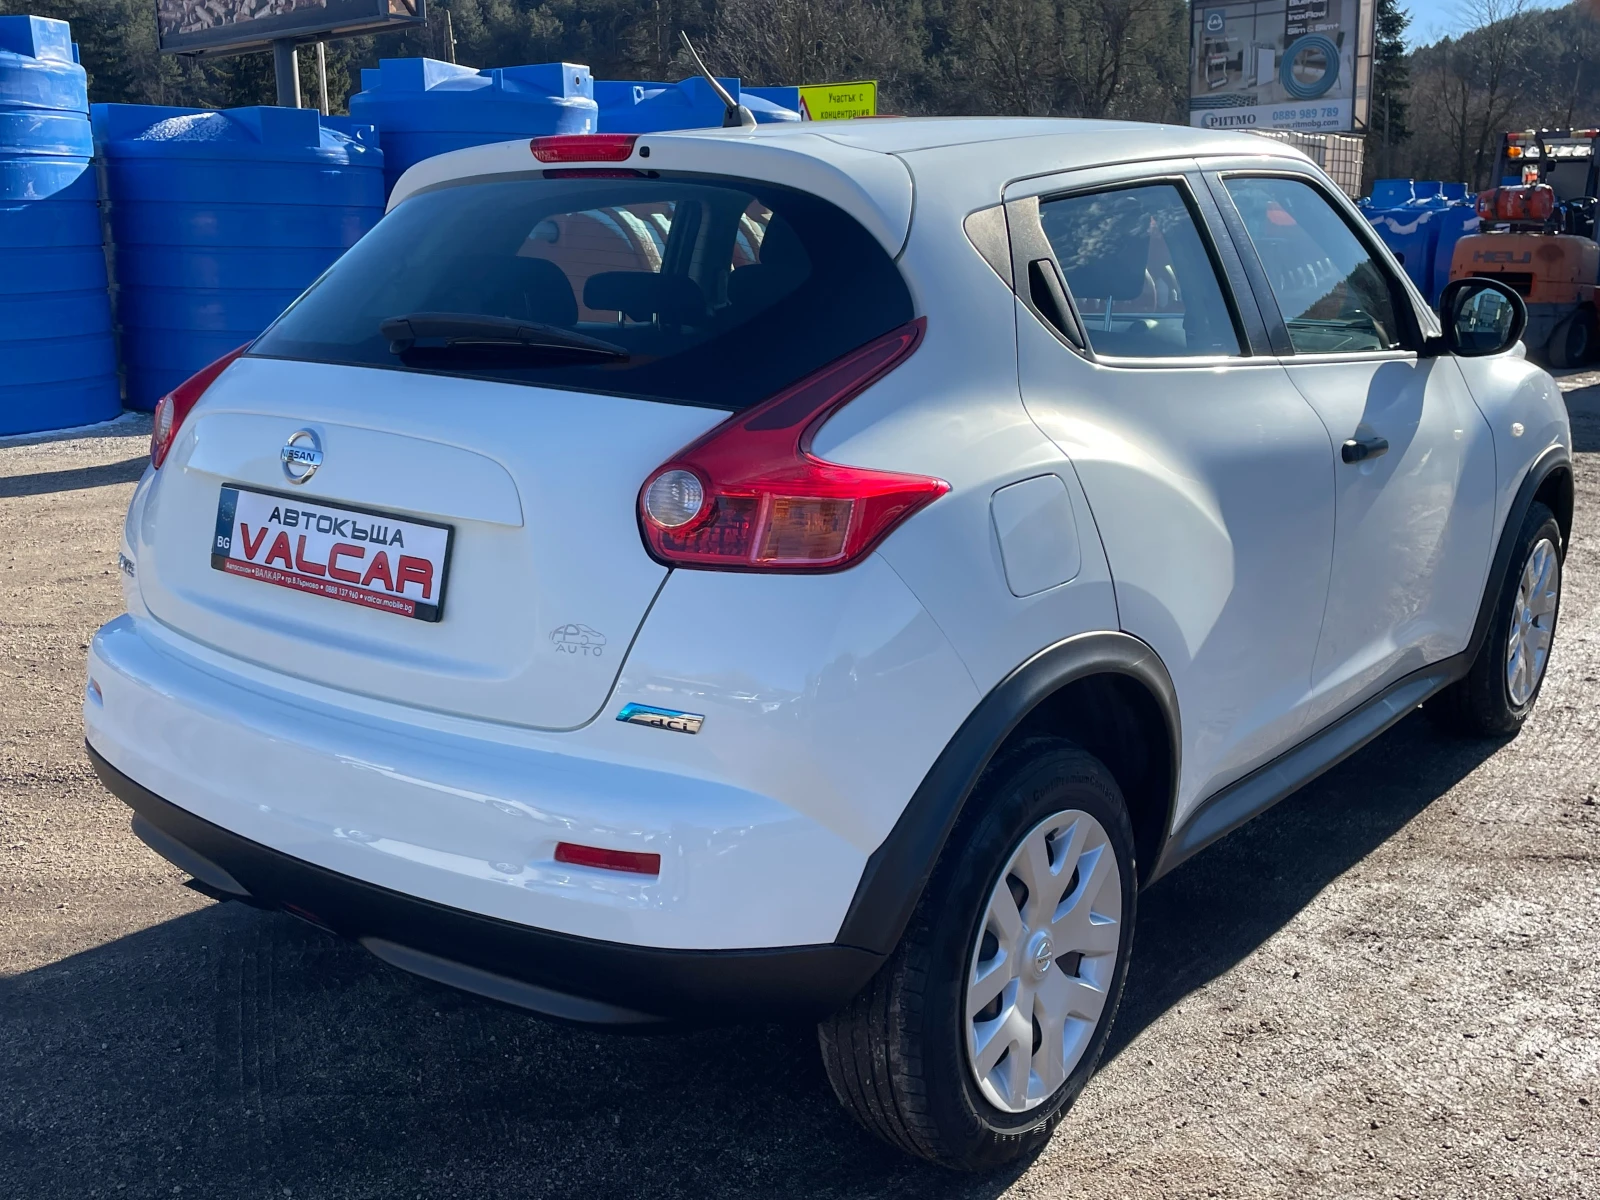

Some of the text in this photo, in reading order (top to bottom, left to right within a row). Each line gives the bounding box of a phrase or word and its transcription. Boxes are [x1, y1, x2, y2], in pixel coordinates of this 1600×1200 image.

[1288, 10, 1327, 21] InoxFlow
[828, 92, 864, 103] Участък с
[1210, 113, 1257, 127] РИТМО
[1272, 106, 1339, 121] 0889 989 789
[1272, 119, 1339, 129] www.ritmobg.com
[281, 448, 316, 462] NISSAN
[268, 506, 404, 549] АВТОКЪЩА
[217, 535, 231, 549] BG
[240, 522, 434, 600] VALCAR
[255, 567, 282, 581] ВАЛКАР
[338, 587, 348, 597] 137
[348, 590, 359, 599] 960
[555, 643, 603, 657] AUTO
